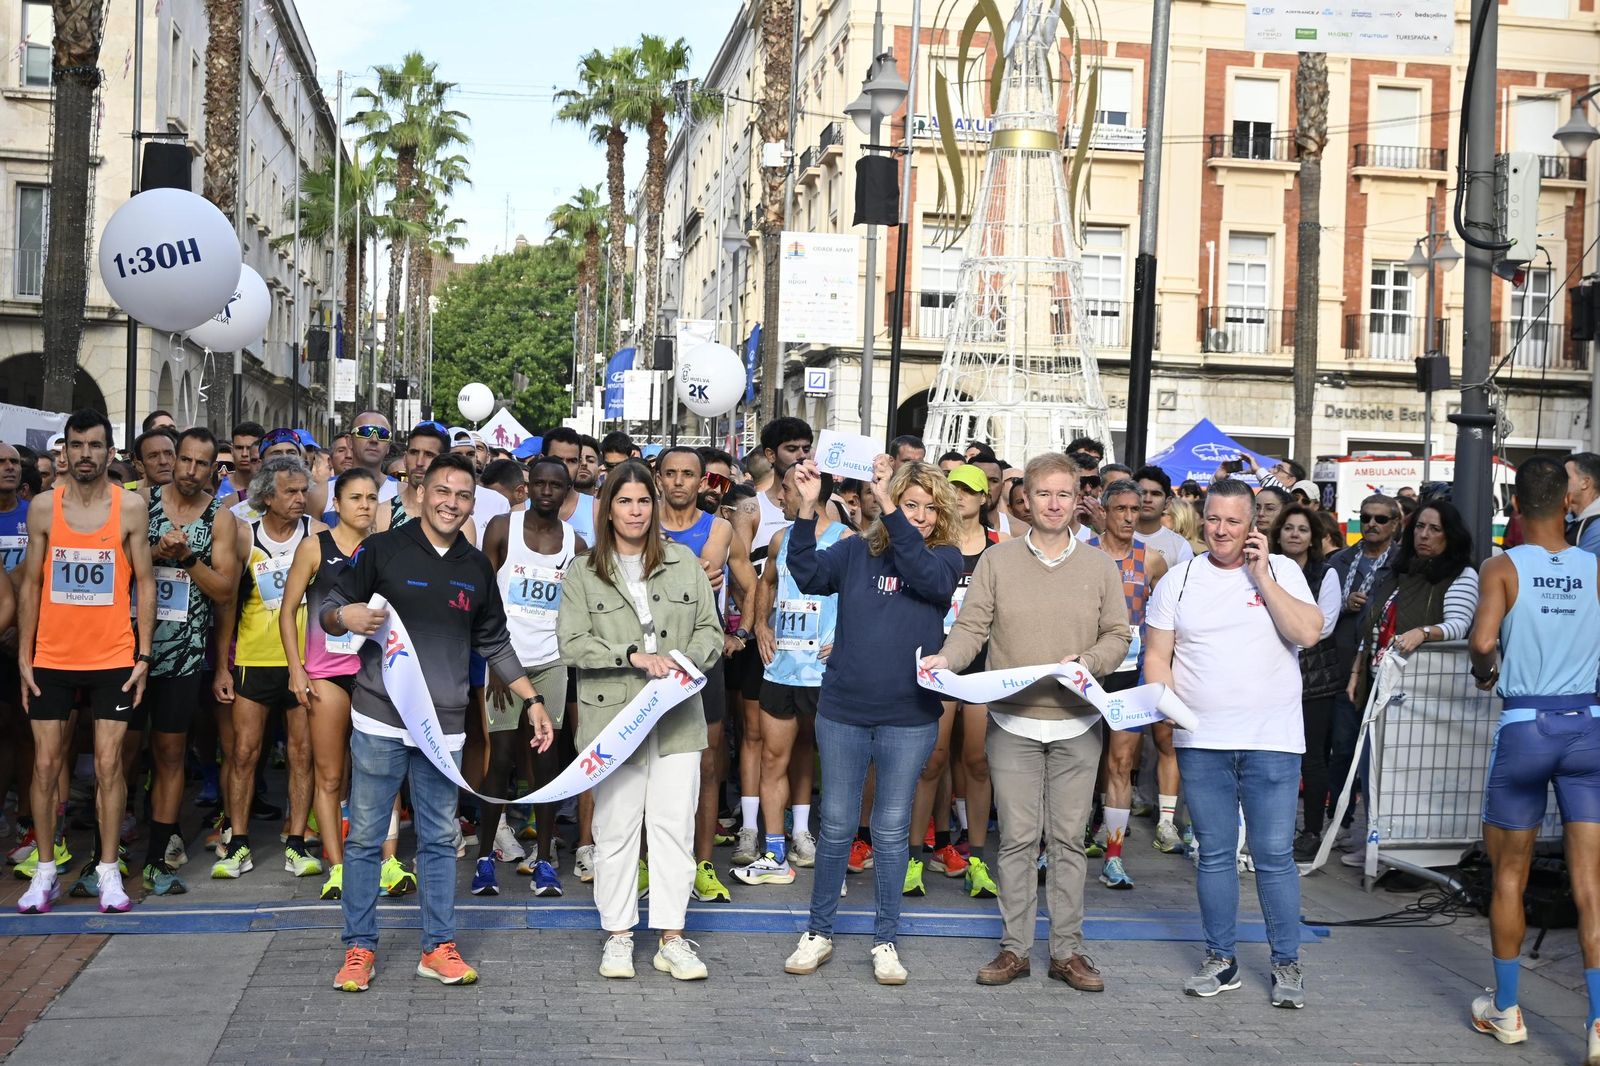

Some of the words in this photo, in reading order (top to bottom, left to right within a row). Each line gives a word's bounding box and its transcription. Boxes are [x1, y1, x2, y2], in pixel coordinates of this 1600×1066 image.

[113, 237, 202, 279] 1:30H
[1325, 403, 1394, 422] Deutsche
[1354, 467, 1417, 476] AMBULANCIA
[61, 563, 105, 585] 106
[519, 578, 558, 602] 180
[1532, 575, 1583, 593] nerja
[1541, 593, 1577, 601] ATLETISMO
[1550, 606, 1576, 615] cajamar
[780, 612, 806, 632] 111
